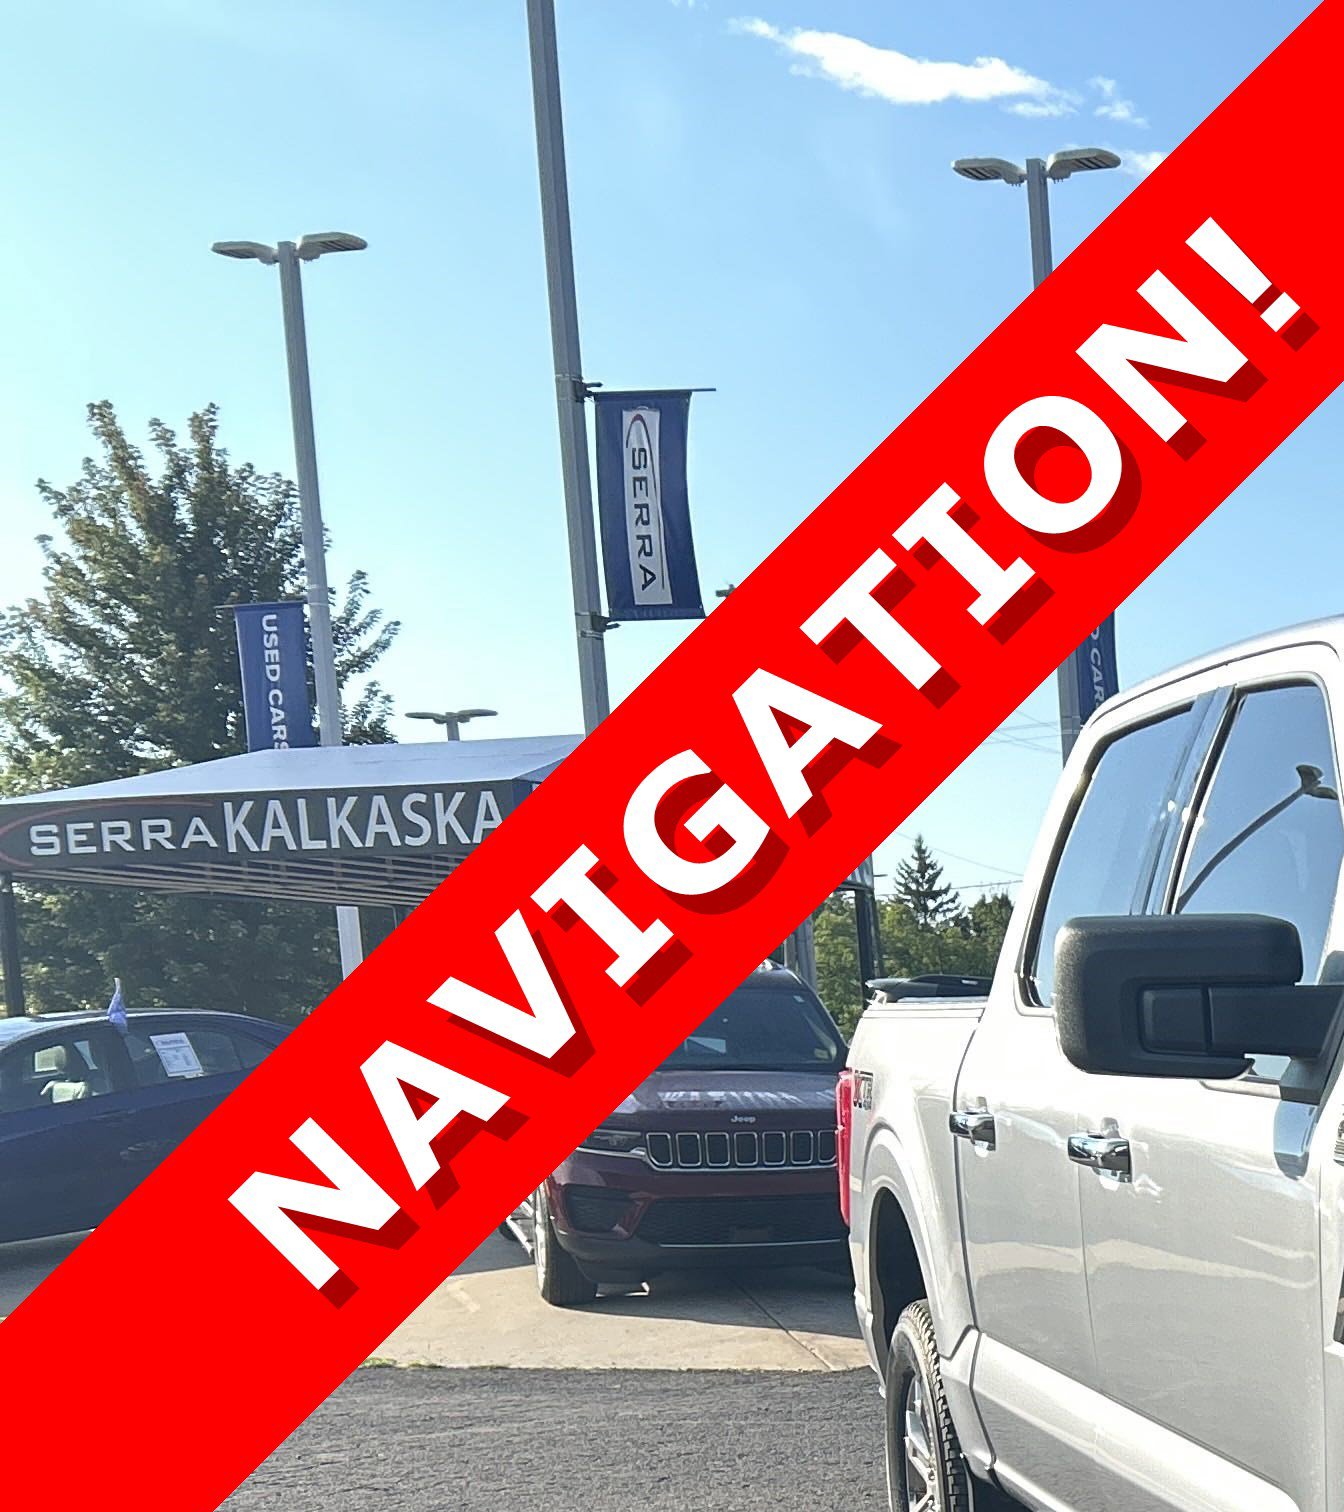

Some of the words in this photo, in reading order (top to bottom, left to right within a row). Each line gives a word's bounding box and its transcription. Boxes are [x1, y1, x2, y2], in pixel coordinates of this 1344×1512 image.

[631, 447, 657, 592] SERRA
[262, 614, 281, 682] USED
[1091, 648, 1105, 708] CAR
[29, 816, 218, 856] SERRA
[223, 791, 503, 853] KALKASKA
